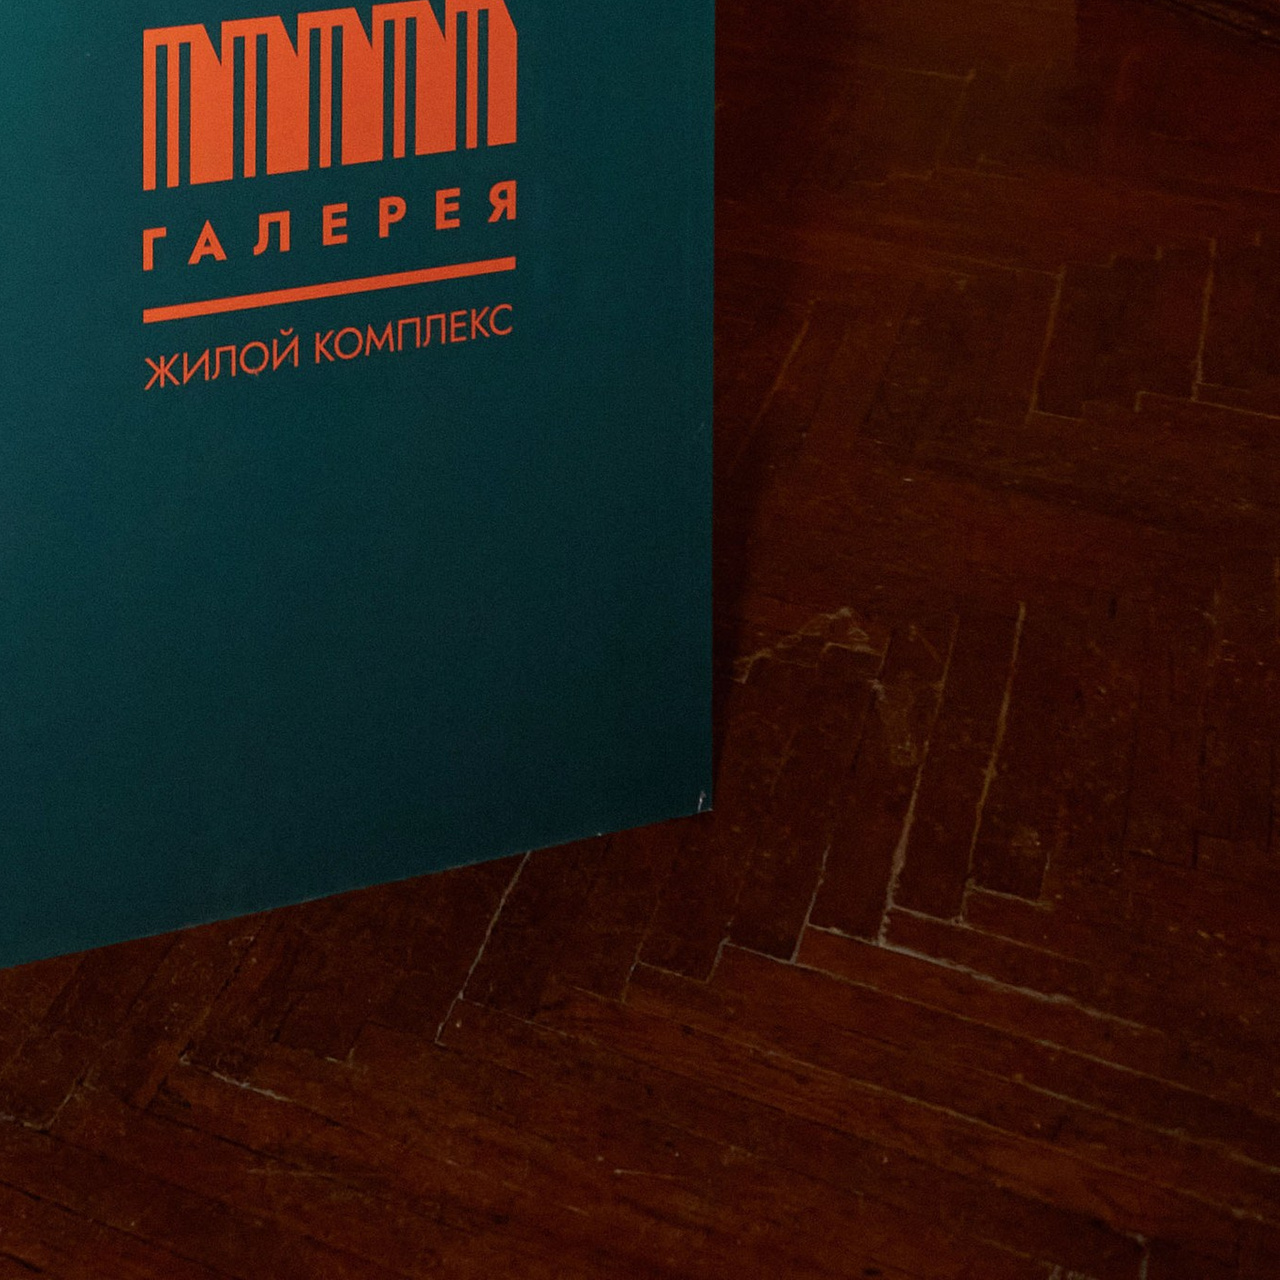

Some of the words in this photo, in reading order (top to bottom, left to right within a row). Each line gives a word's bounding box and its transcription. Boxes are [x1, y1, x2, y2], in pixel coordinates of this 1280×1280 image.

[142, 179, 518, 272] ГАЛЕРЕЯ
[144, 327, 300, 391] ЖИЛОЙ
[314, 303, 514, 364] КОМПЛЕКС
